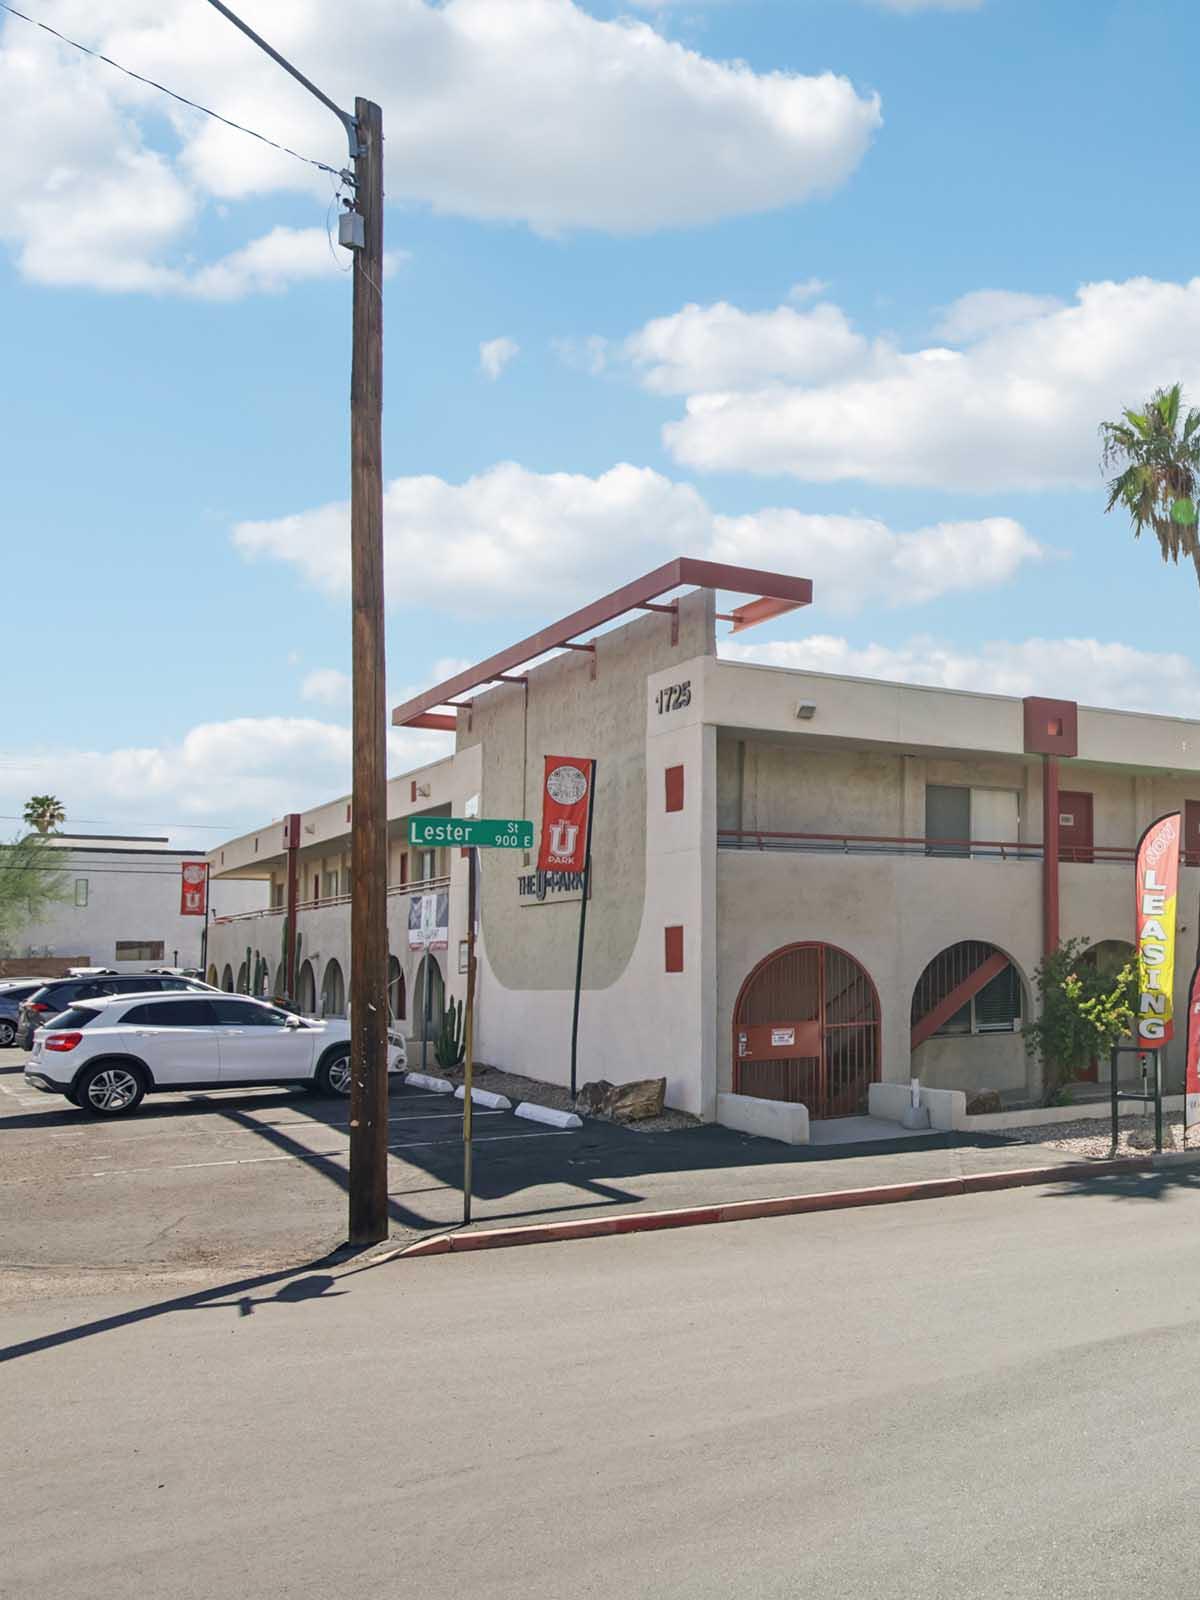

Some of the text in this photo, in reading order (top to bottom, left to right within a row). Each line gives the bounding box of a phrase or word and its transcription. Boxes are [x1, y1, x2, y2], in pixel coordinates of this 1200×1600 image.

[656, 680, 692, 715] 1725
[411, 822, 473, 843] Lester
[507, 822, 519, 834] St
[495, 835, 531, 847] 900 E
[549, 824, 579, 857] U
[547, 856, 575, 865] PARK
[1138, 869, 1168, 1040] LEASING
